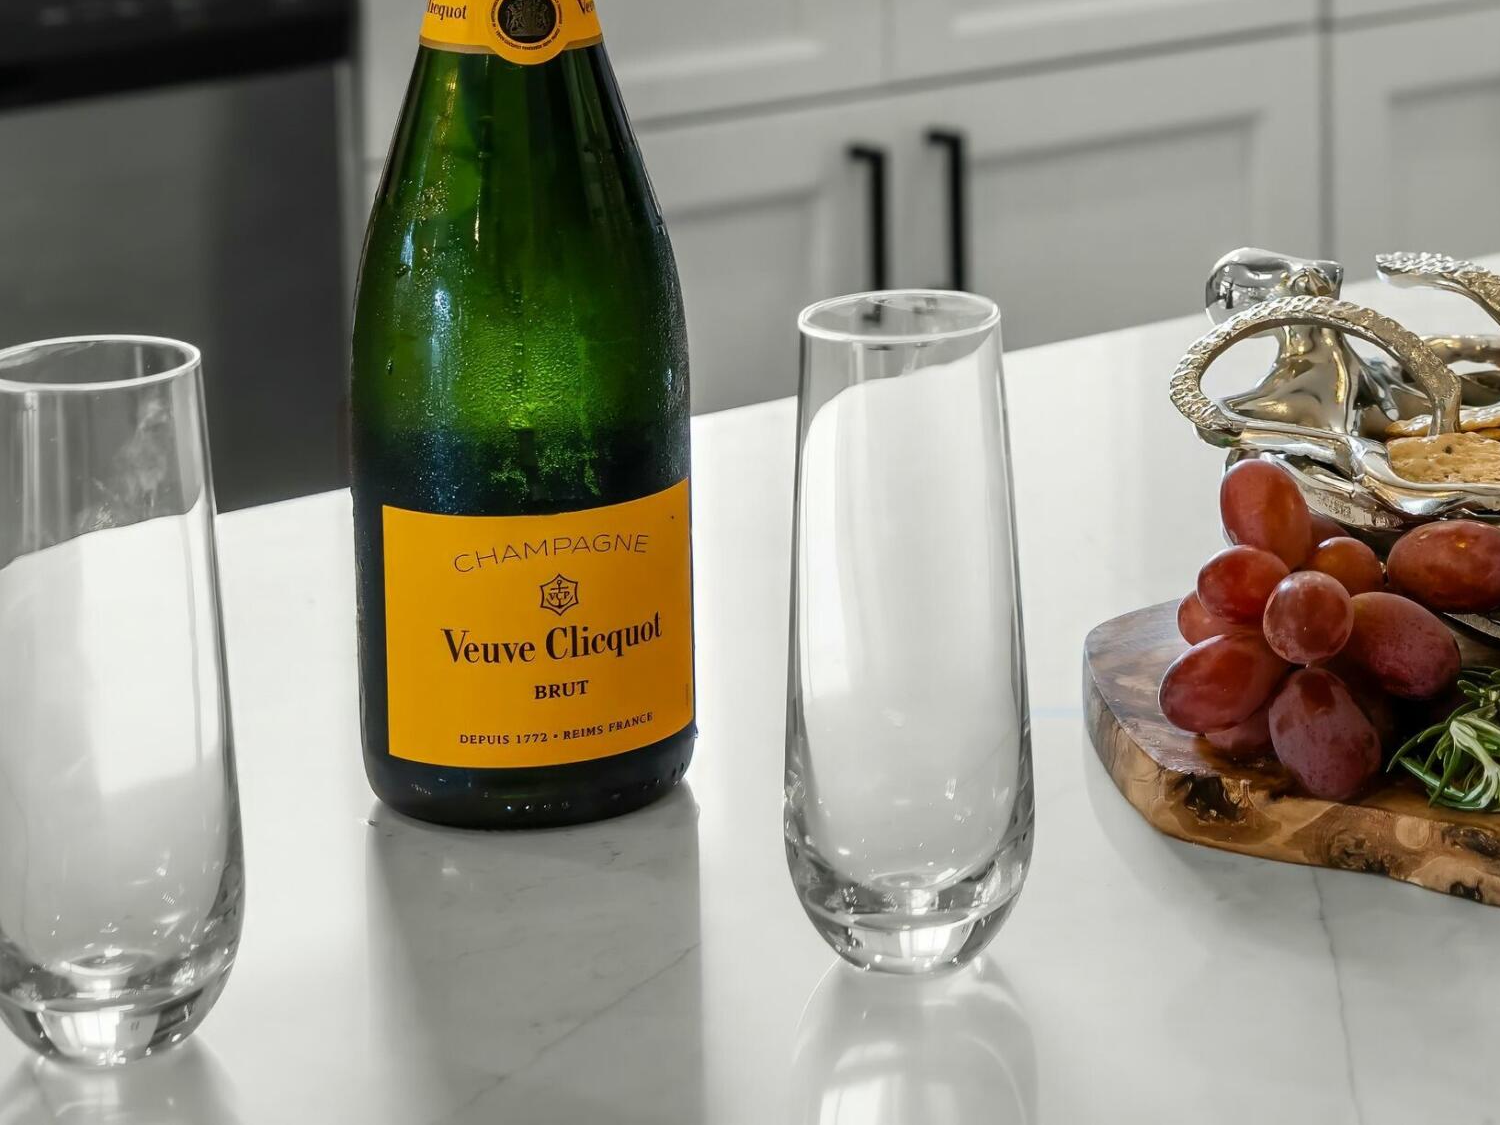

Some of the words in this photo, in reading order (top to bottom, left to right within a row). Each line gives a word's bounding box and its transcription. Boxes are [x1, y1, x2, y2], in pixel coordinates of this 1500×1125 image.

[453, 533, 649, 573] CHAMPAGNE
[440, 628, 536, 664] Veuve
[545, 610, 663, 660] Clicquot
[534, 679, 589, 700] BRUT
[459, 733, 510, 745] DEPUIS
[516, 732, 548, 744] 1772
[563, 724, 604, 741] REIMS
[608, 711, 654, 733] FRANCE
